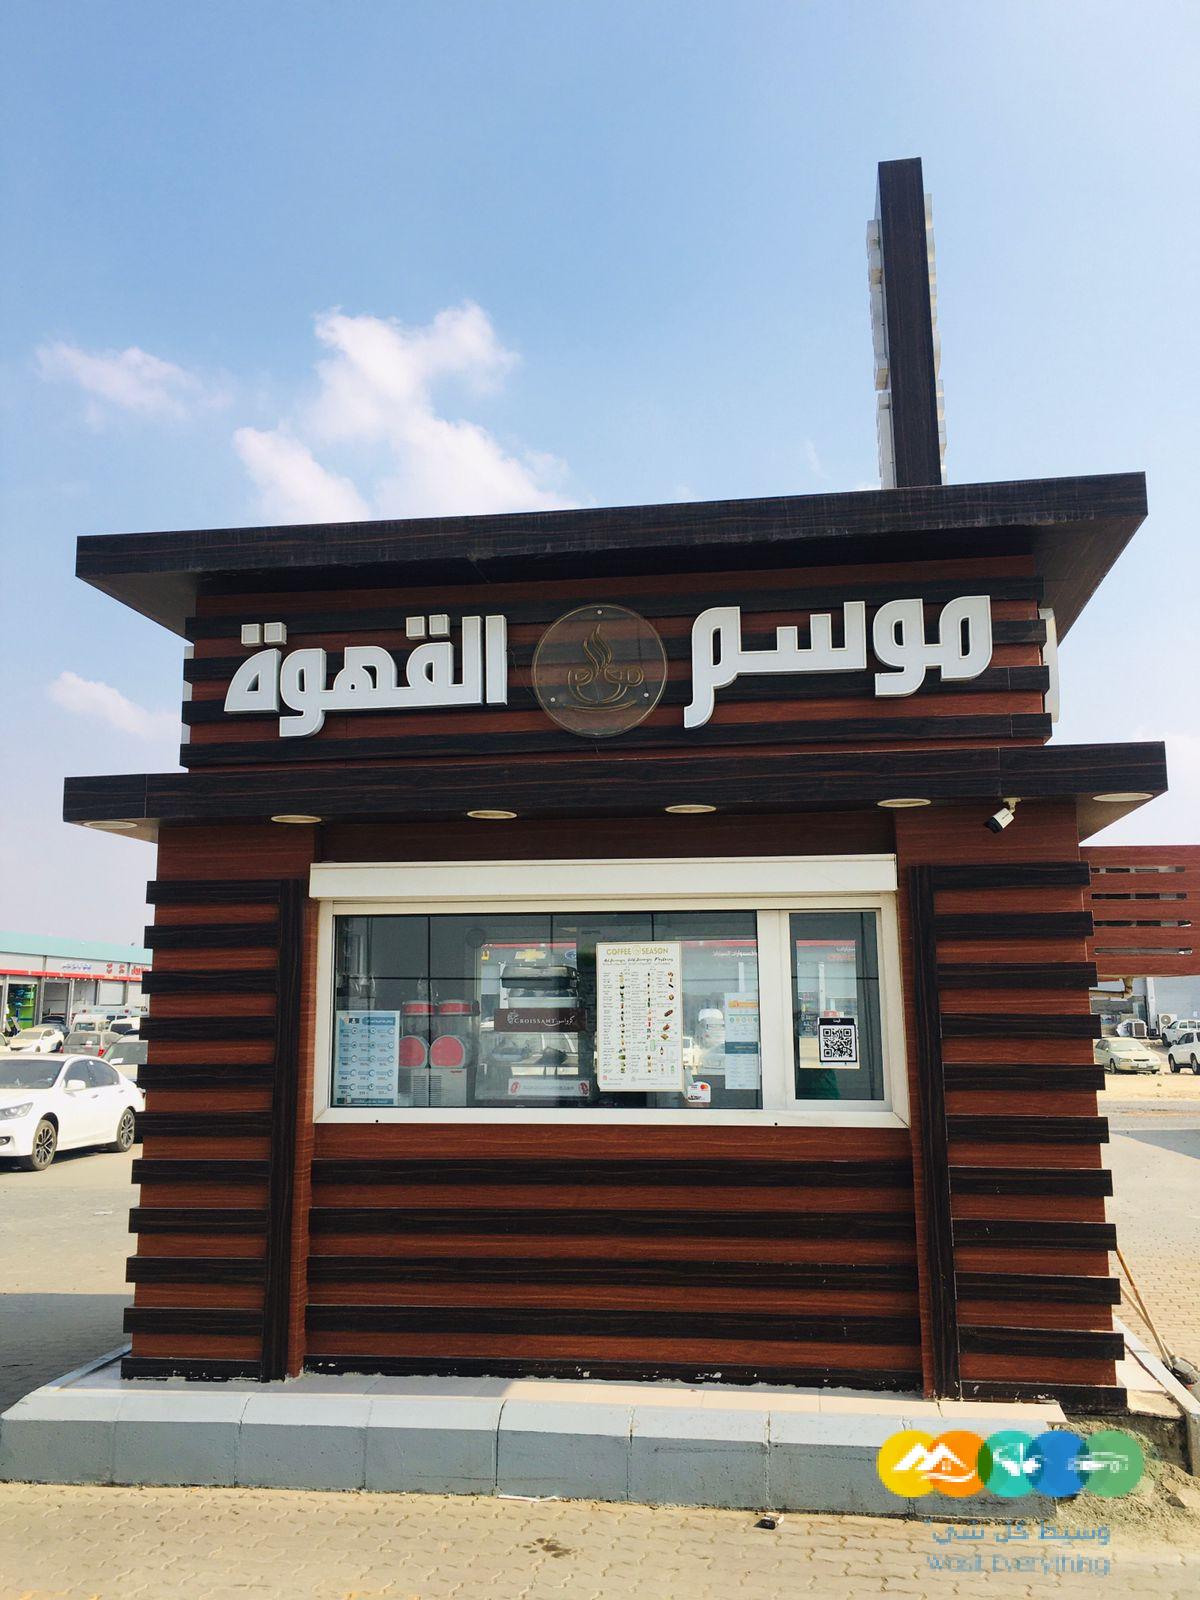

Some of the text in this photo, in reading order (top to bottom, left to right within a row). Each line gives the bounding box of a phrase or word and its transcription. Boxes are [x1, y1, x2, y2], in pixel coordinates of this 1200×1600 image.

[223, 595, 993, 738] موسم القهوة
[606, 946, 669, 956] COFFEE SEASON
[513, 1016, 556, 1025] CROISSANT
